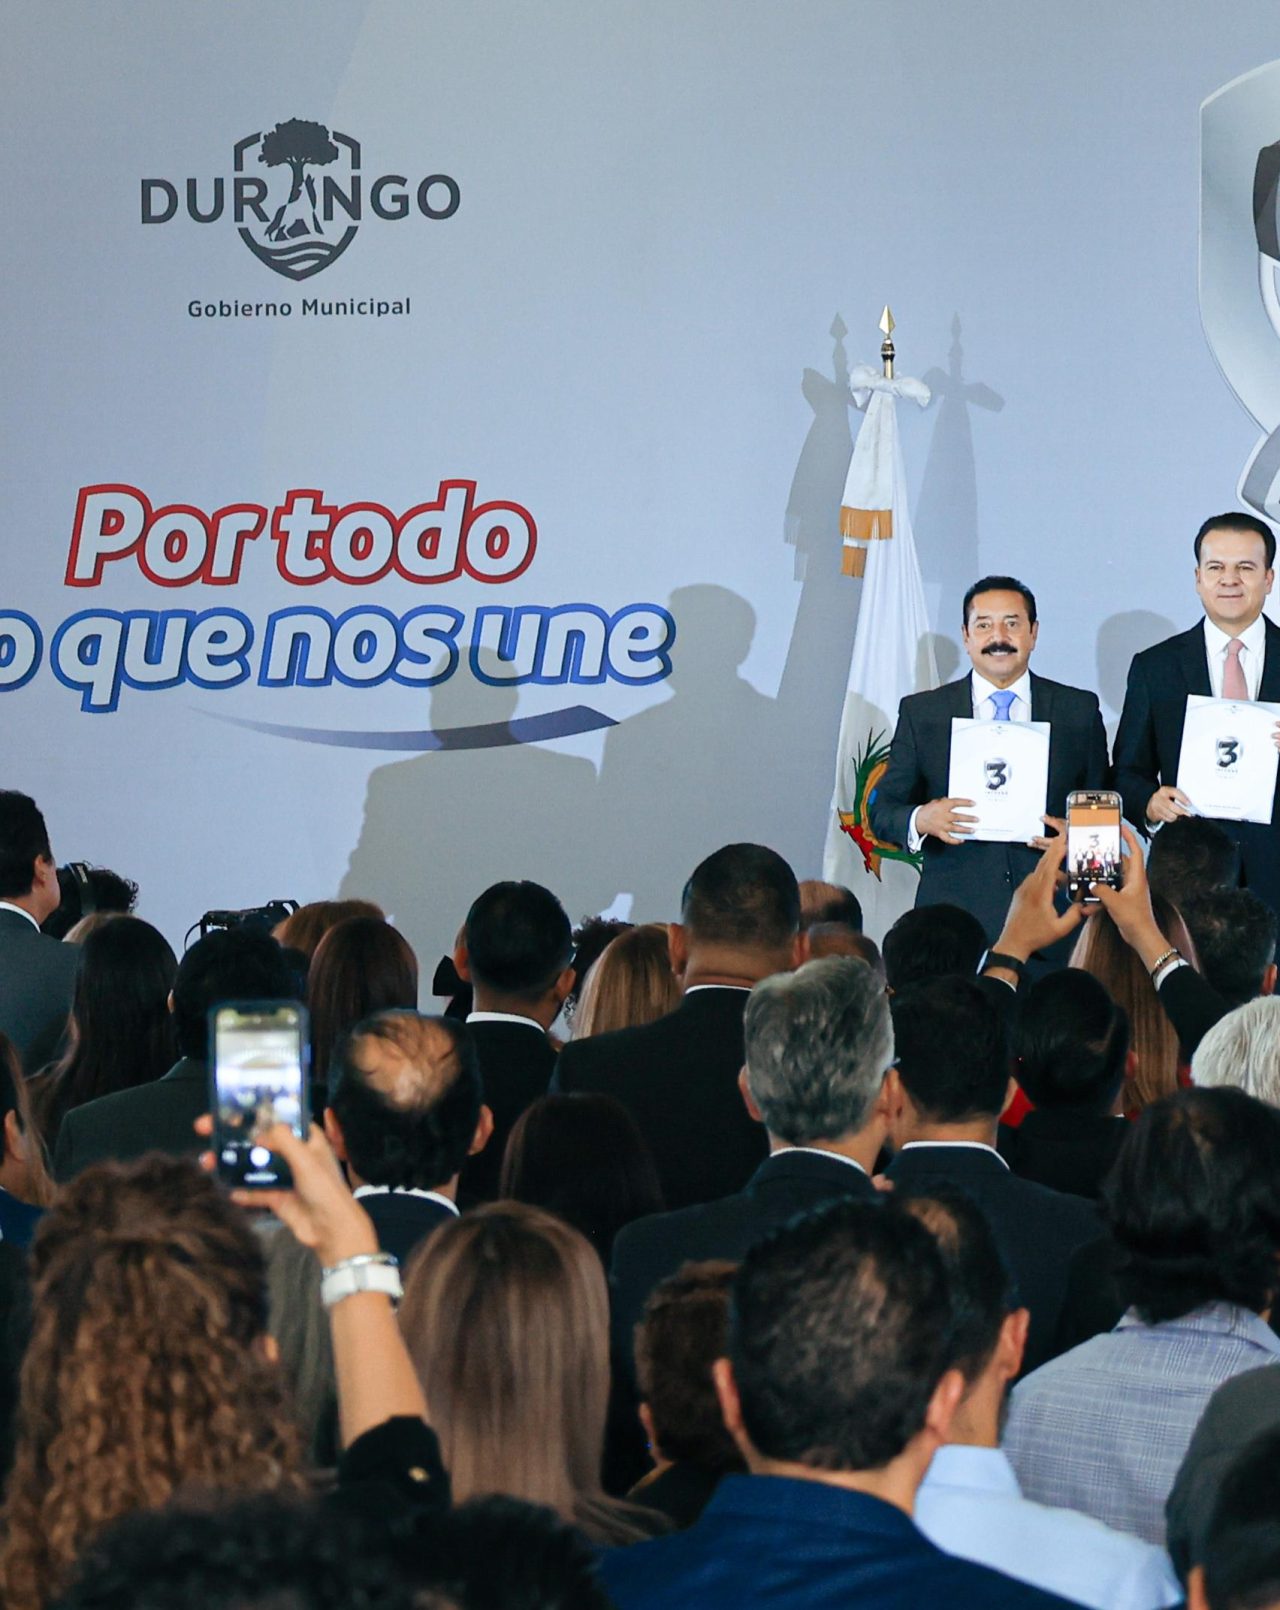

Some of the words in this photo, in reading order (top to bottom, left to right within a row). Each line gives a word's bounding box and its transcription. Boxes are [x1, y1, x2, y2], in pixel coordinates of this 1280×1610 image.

[141, 173, 461, 224] DURANGO
[188, 300, 292, 317] Gobierno
[302, 298, 411, 317] Municipal
[64, 484, 267, 588] Por
[271, 479, 538, 585] todo
[50, 608, 253, 714] que
[257, 605, 464, 687] nos
[470, 603, 676, 687] une
[1218, 741, 1239, 768] 3
[986, 762, 1007, 790] 3
